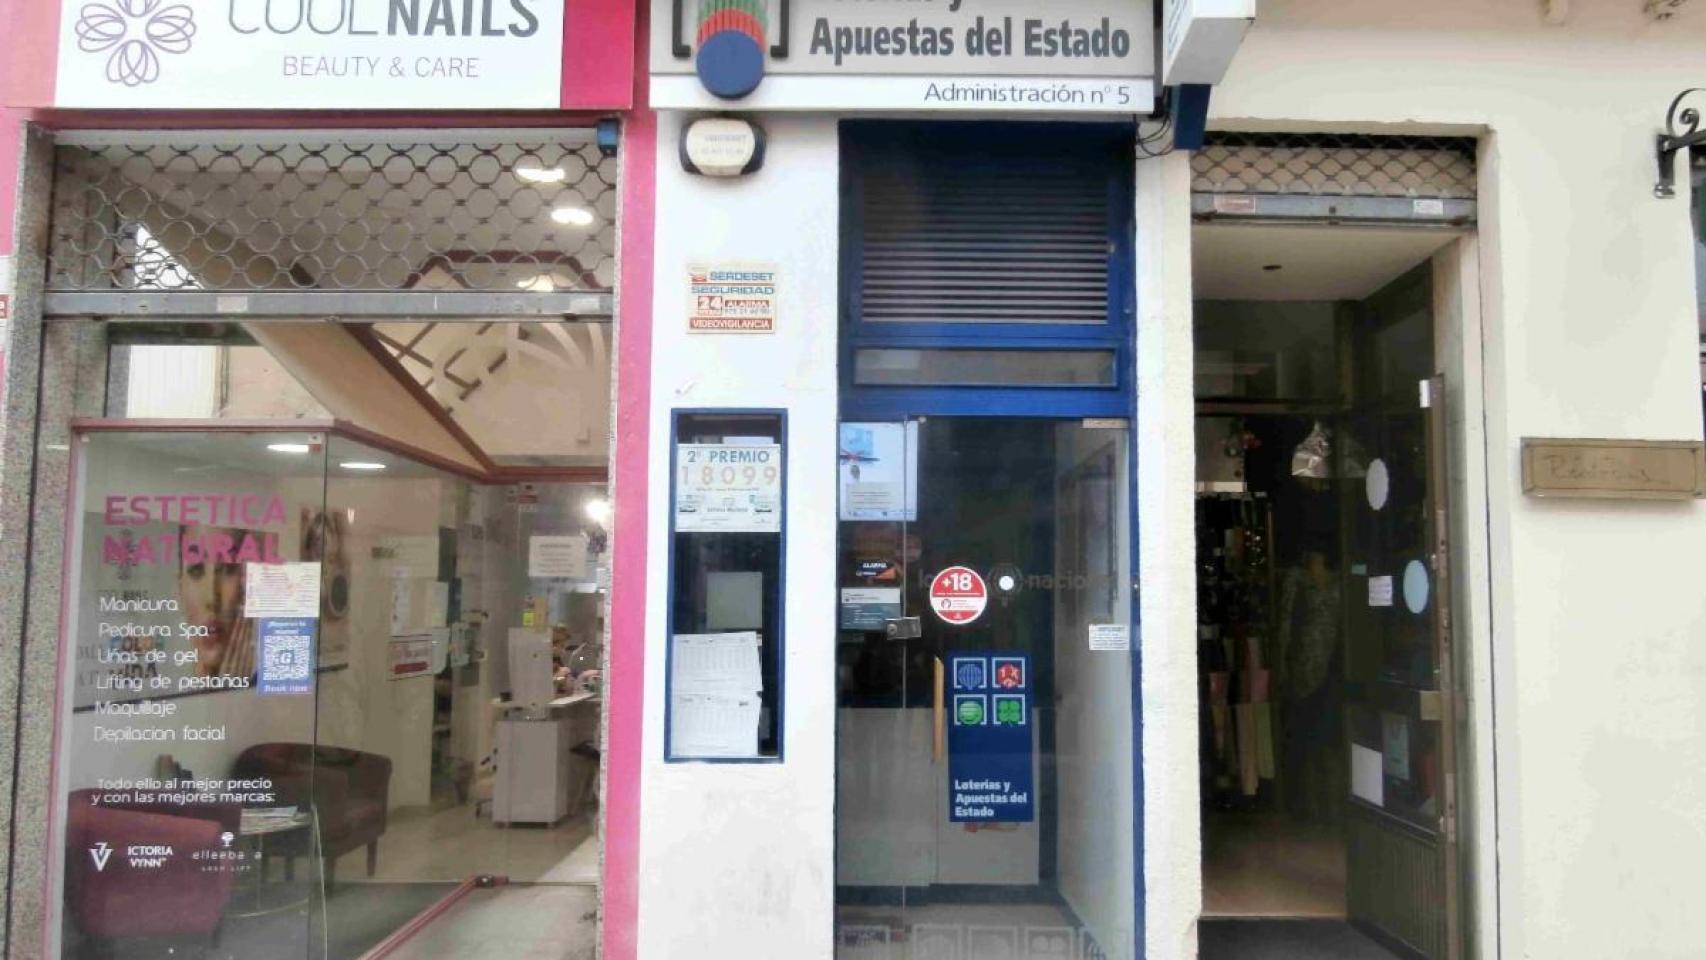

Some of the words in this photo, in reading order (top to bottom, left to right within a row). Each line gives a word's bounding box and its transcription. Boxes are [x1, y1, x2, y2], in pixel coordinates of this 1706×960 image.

[387, 0, 539, 37] NAILS
[810, 16, 954, 64] Apuestas
[965, 17, 1012, 57] del
[1023, 17, 1130, 58] Estado
[282, 56, 380, 77] BEAUTY
[388, 56, 405, 77] &
[414, 57, 479, 78] CARE
[924, 81, 1085, 104] Administración
[1117, 86, 1130, 104] 5
[710, 271, 774, 281] SERDESET
[691, 286, 775, 295] SEGURIDAD
[692, 319, 771, 328] VIDEOVIGILANCIA
[709, 450, 770, 462] PREMIO
[681, 466, 776, 485] 18099
[104, 493, 286, 525] ESTETICA
[103, 532, 286, 565] NATURAL
[942, 573, 973, 592] +18
[100, 597, 178, 611] Manicura
[100, 622, 171, 637] Pedicura
[179, 622, 209, 640] Spa
[144, 648, 167, 663] de
[174, 648, 199, 666] gel
[150, 673, 171, 689] de
[178, 673, 249, 690] pestañas
[94, 700, 177, 718] Maquillaje
[93, 726, 176, 744] Depilacion
[183, 726, 226, 741] facial
[97, 778, 132, 789] Todo
[135, 778, 162, 789] ello
[165, 778, 177, 789] al
[181, 779, 223, 792] mejor
[227, 778, 273, 793] precio
[1003, 781, 1011, 793] y
[91, 794, 101, 806] y
[104, 793, 131, 803] con
[135, 791, 154, 803] las
[159, 791, 217, 805] mejores
[955, 793, 1009, 805] Apuestas
[1010, 792, 1028, 803] del
[954, 806, 995, 817] Estado
